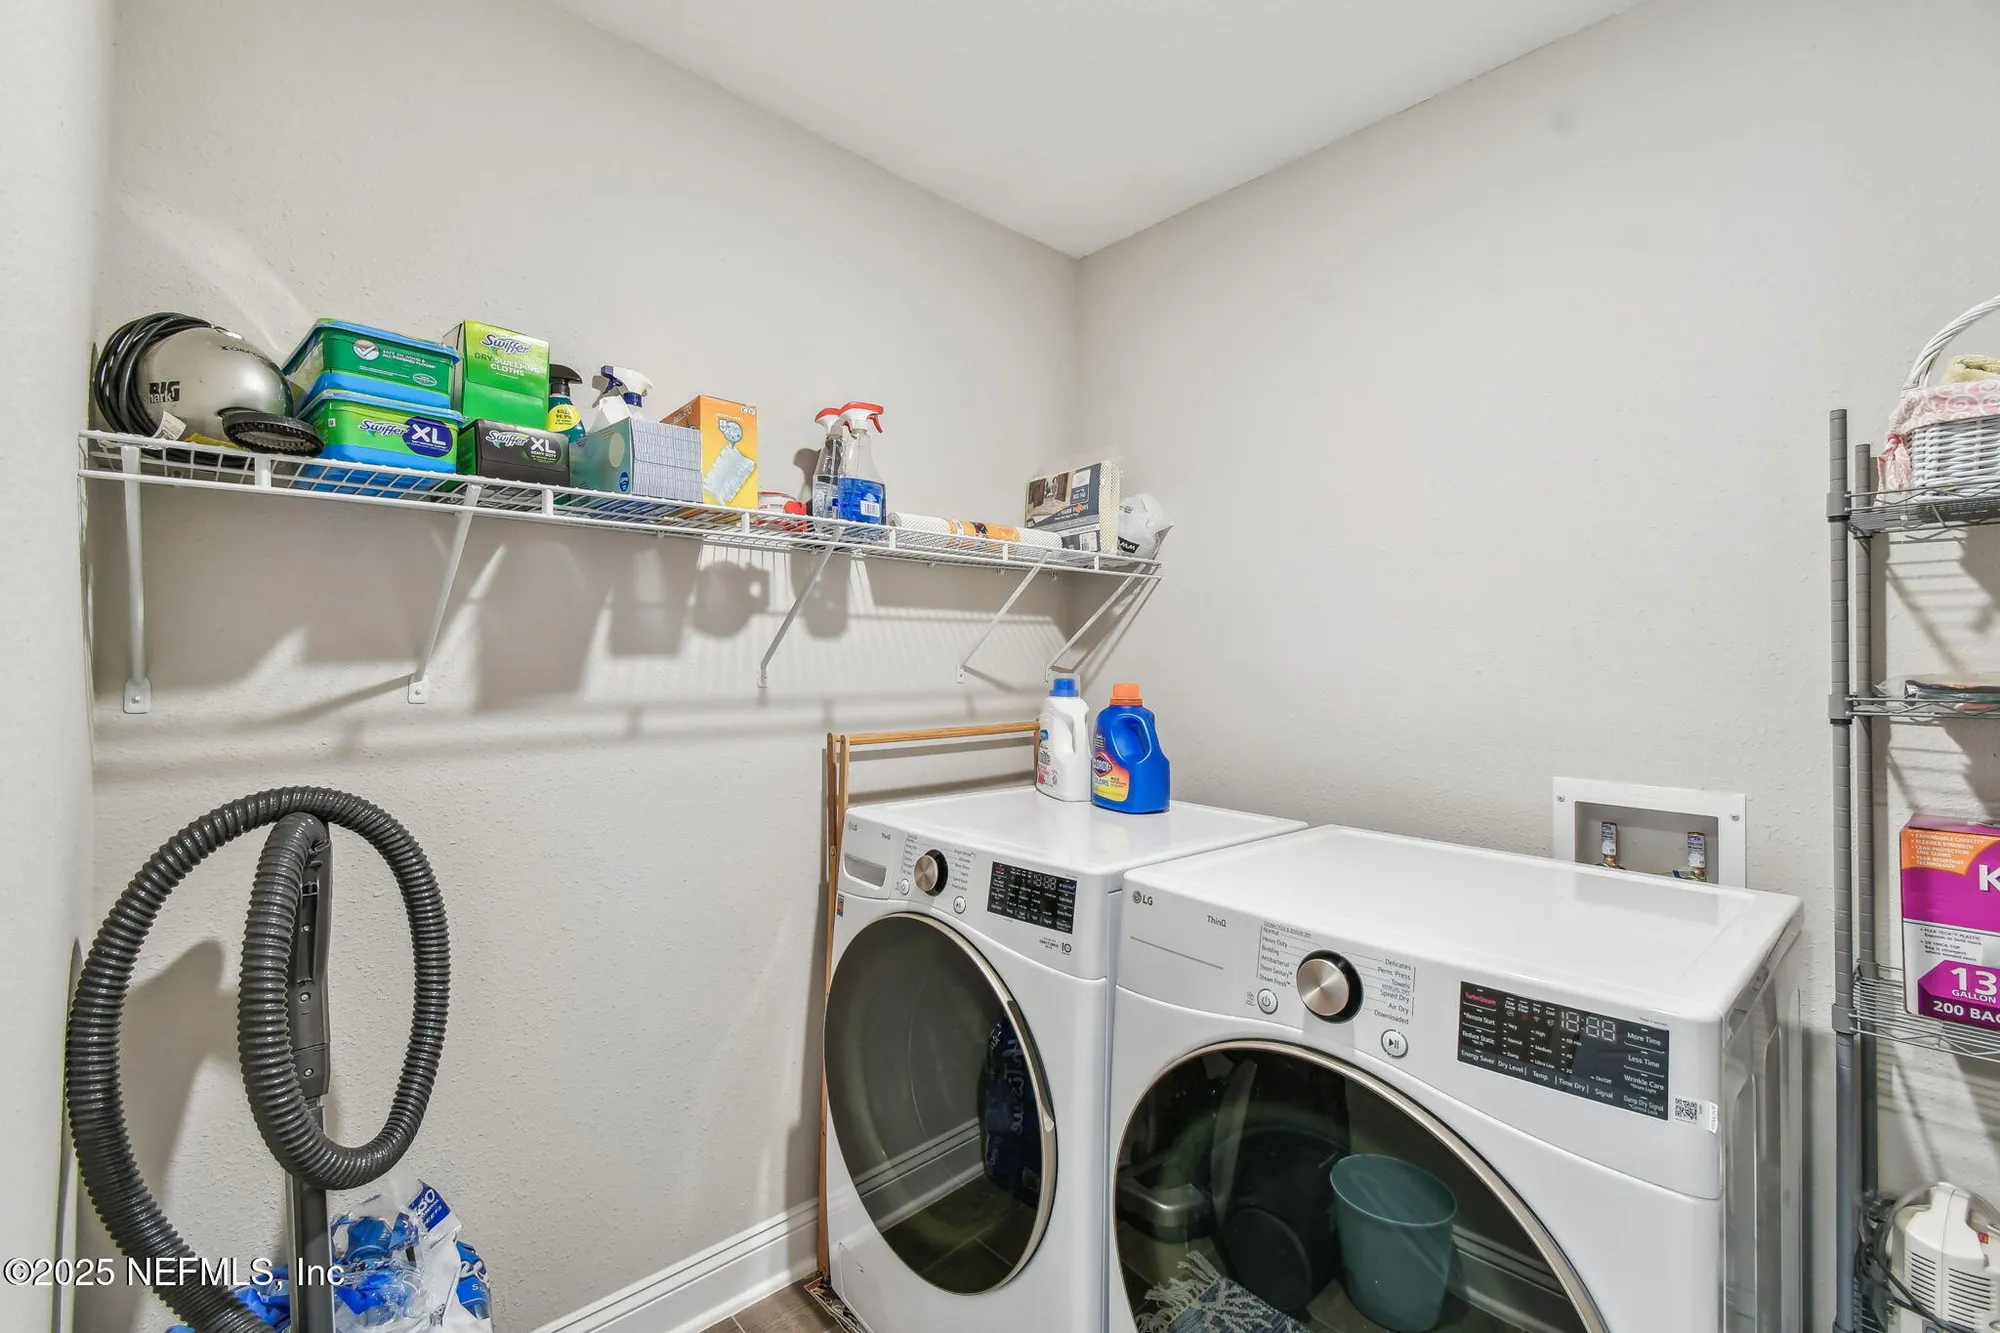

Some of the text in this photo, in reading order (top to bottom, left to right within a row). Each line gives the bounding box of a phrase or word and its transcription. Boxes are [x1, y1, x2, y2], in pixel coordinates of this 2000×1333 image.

[481, 334, 531, 354] Swiffer
[474, 352, 542, 374] DRY SWEEPING
[491, 363, 525, 377] CLOTHS
[358, 419, 410, 436] Swiffer
[411, 423, 446, 446] XL
[485, 430, 556, 454] Swiffer XL
[1207, 915, 1227, 928] ThinQ
[1277, 939, 1288, 948] Duty
[1951, 967, 1997, 996] 13
[1952, 989, 1997, 1004] GALLON
[1933, 1001, 1964, 1016] 200
[1375, 1009, 1409, 1025] Downloaded
[1484, 1017, 1496, 1026] Start
[1462, 1030, 1480, 1040] Reduce
[1627, 1032, 1662, 1046] More Time
[1461, 1049, 1495, 1064] Energy Saver
[1628, 1054, 1660, 1069] Less Time
[1498, 1060, 1524, 1074] Dry Level
[1559, 1078, 1586, 1092] Time Dry
[1623, 1074, 1664, 1091] Wrinkle Care
[1595, 1088, 1614, 1099] Signal
[1623, 1095, 1664, 1112] Damp Dry Signal
